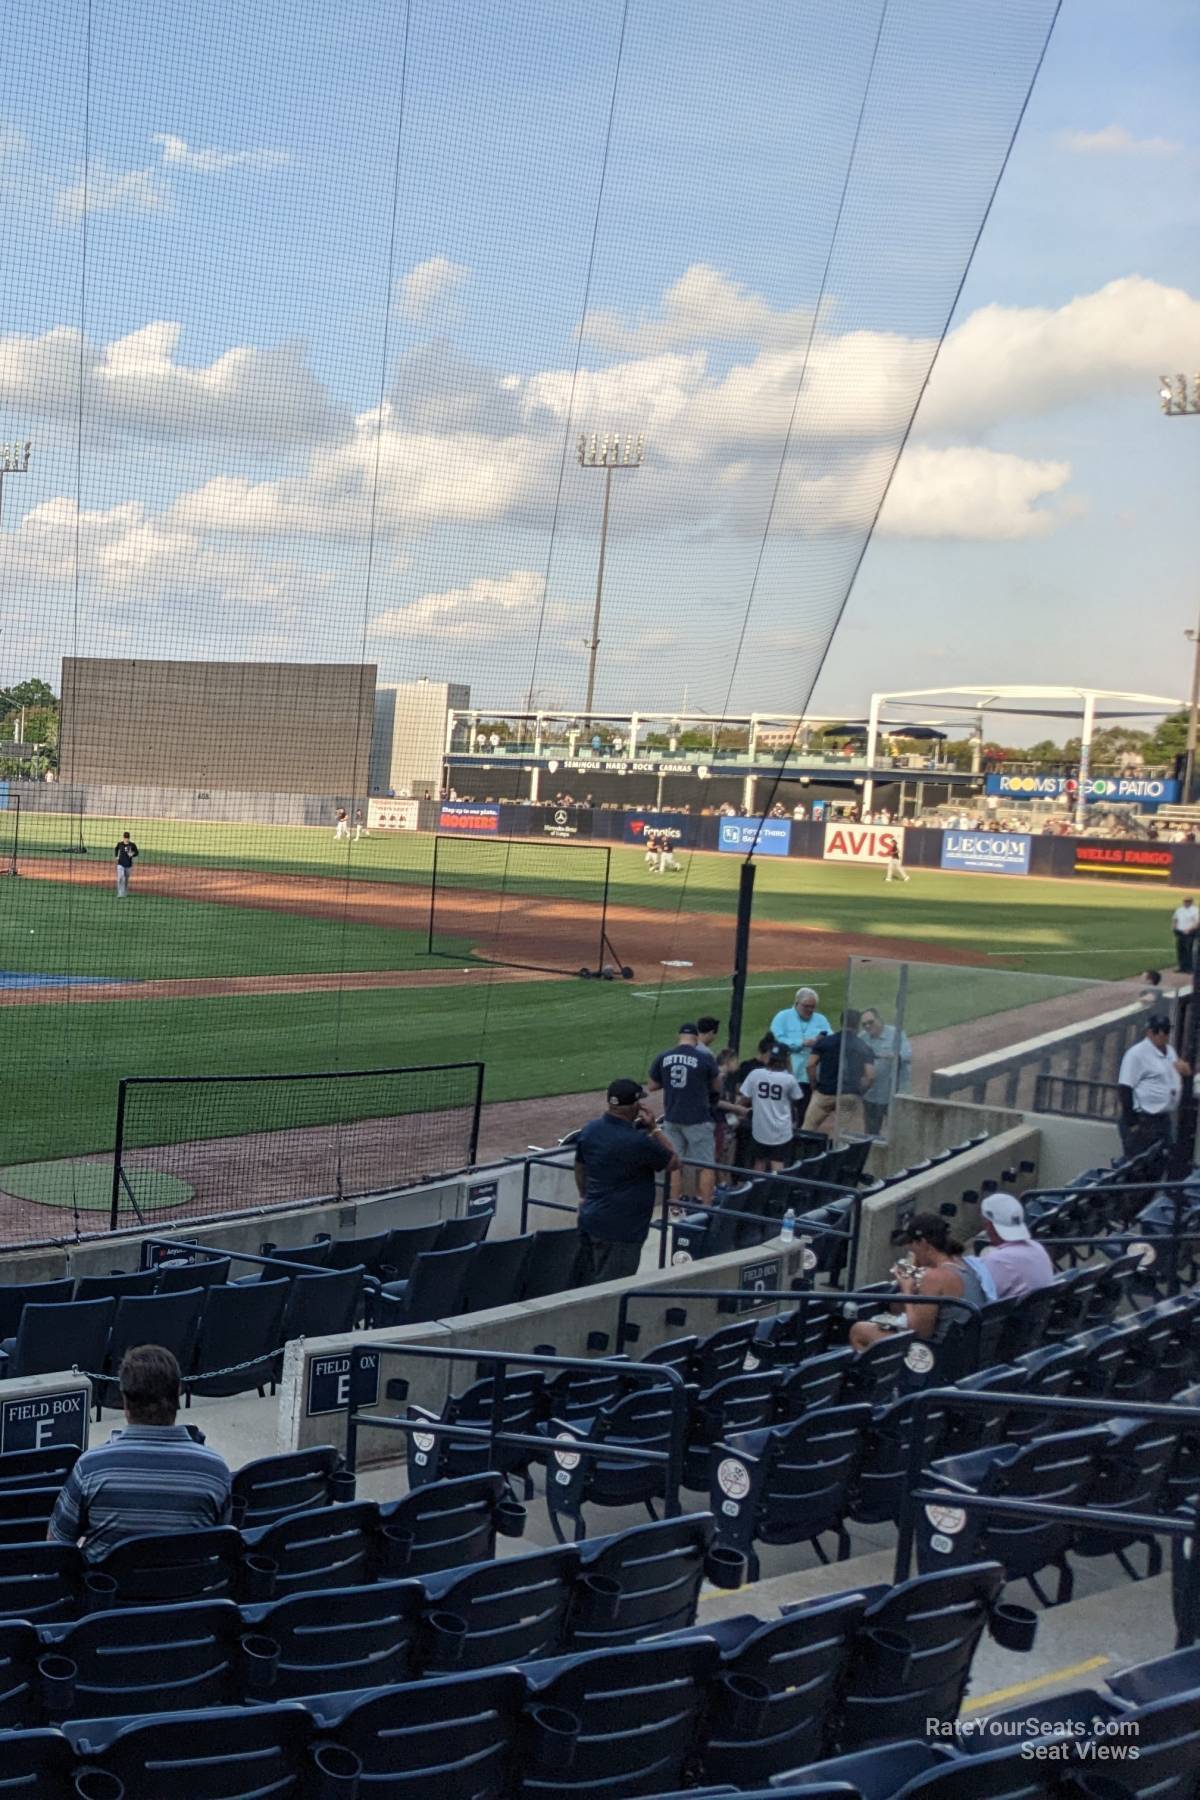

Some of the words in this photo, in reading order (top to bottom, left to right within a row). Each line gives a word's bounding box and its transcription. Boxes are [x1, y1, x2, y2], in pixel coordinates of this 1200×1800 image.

[564, 761, 600, 769] SEMINOLE
[605, 762, 628, 770] HARD
[632, 763, 654, 771] ROCK
[1000, 776, 1056, 792] ROOMS
[1056, 779, 1078, 794] TO
[1118, 781, 1166, 797] PATIO
[440, 813, 498, 830] HOOTERS
[643, 825, 682, 838] Fanatics
[827, 830, 896, 858] AVIS
[946, 836, 1026, 856] LECOM
[1076, 847, 1122, 864] WELLS
[1124, 849, 1174, 866] FARGO
[670, 1065, 688, 1089] 9
[758, 1081, 783, 1101] 99
[743, 1268, 763, 1282] FIELD
[763, 1264, 778, 1277] BOX
[316, 1359, 350, 1376] FIELD
[360, 1355, 376, 1370] OX
[337, 1374, 350, 1404] E
[9, 1403, 49, 1421] FIELD
[53, 1398, 81, 1414] BOX
